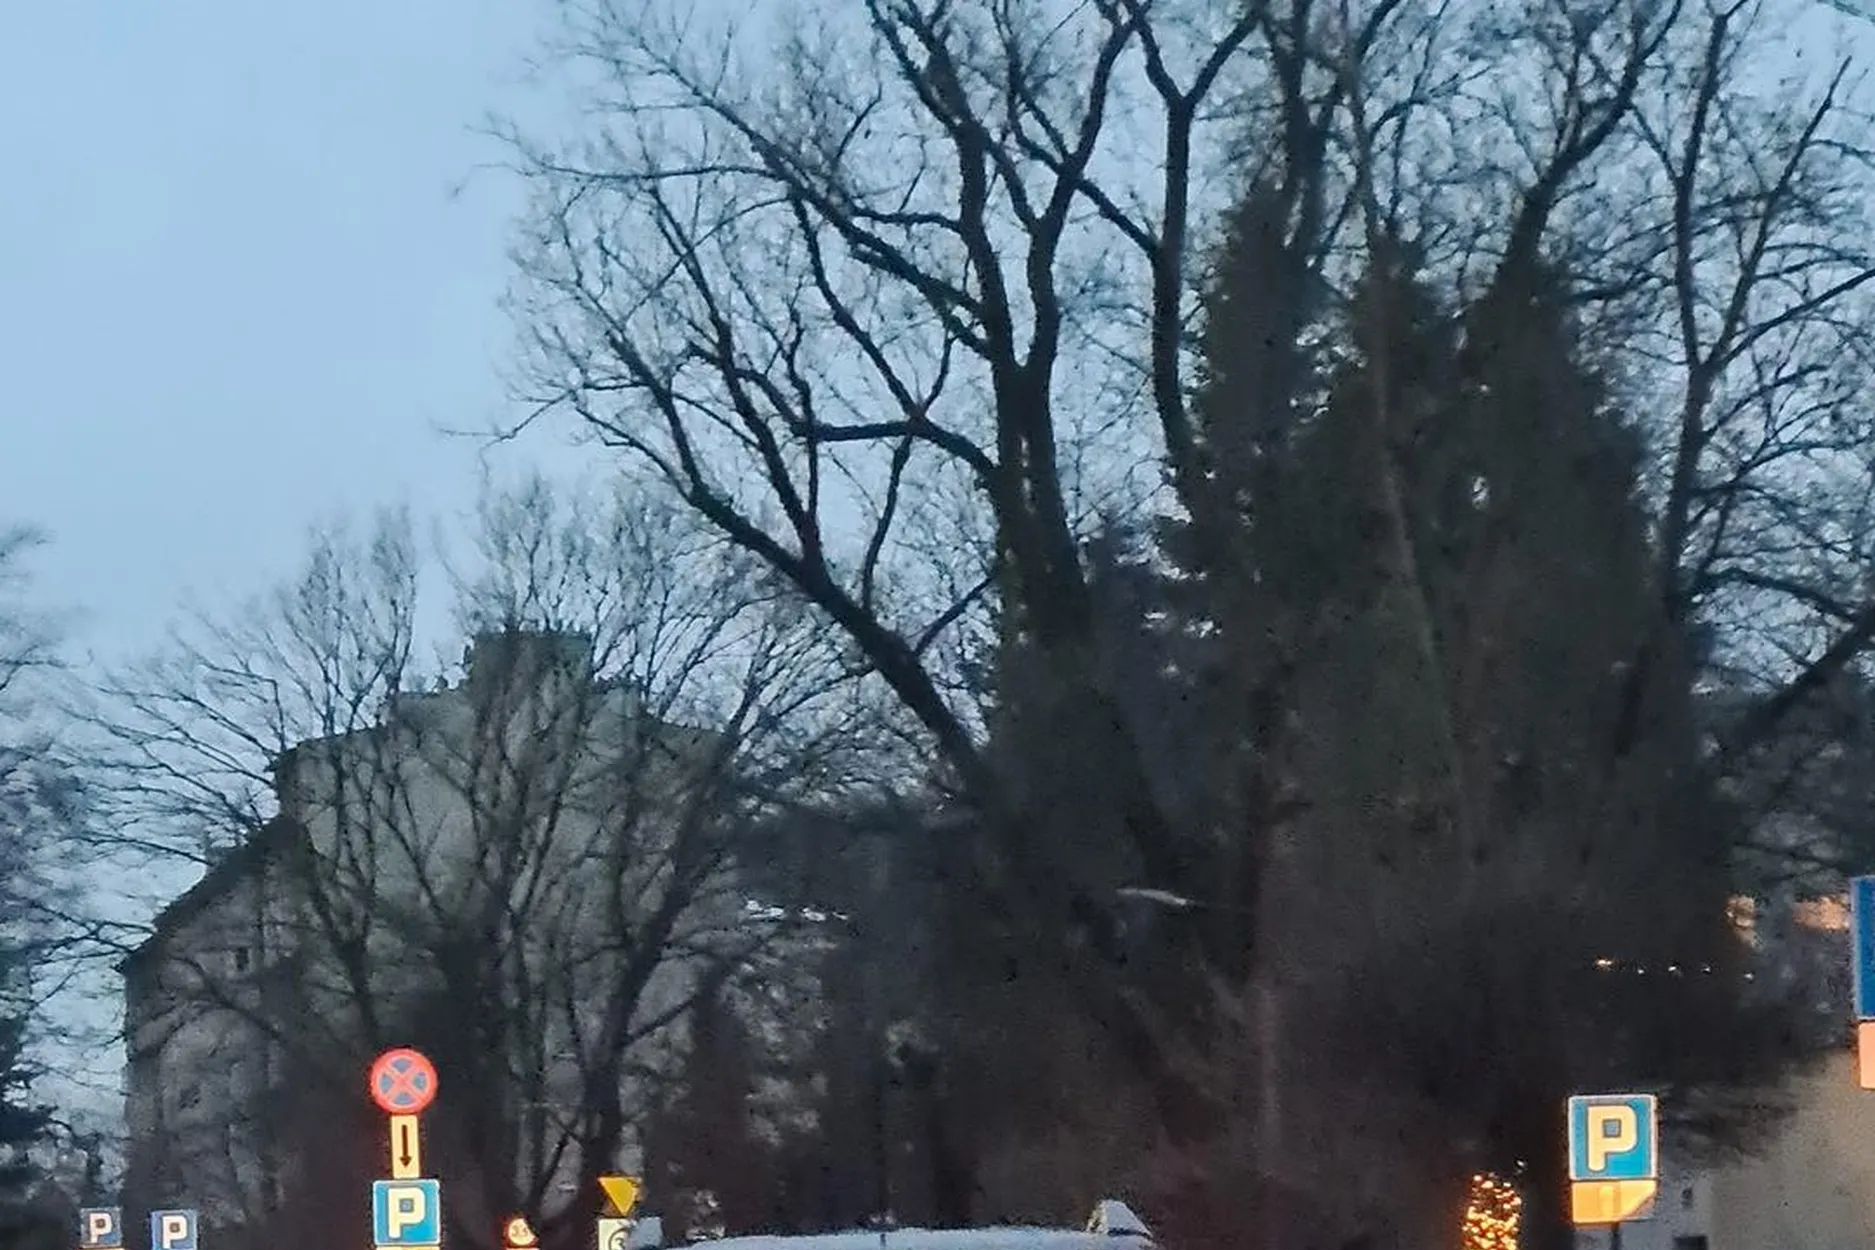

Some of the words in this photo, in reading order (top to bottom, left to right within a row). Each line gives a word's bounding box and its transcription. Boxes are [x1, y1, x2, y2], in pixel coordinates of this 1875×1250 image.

[1587, 1104, 1637, 1171] P
[90, 1212, 112, 1243] P
[162, 1215, 188, 1249] P
[388, 1187, 425, 1238] P
